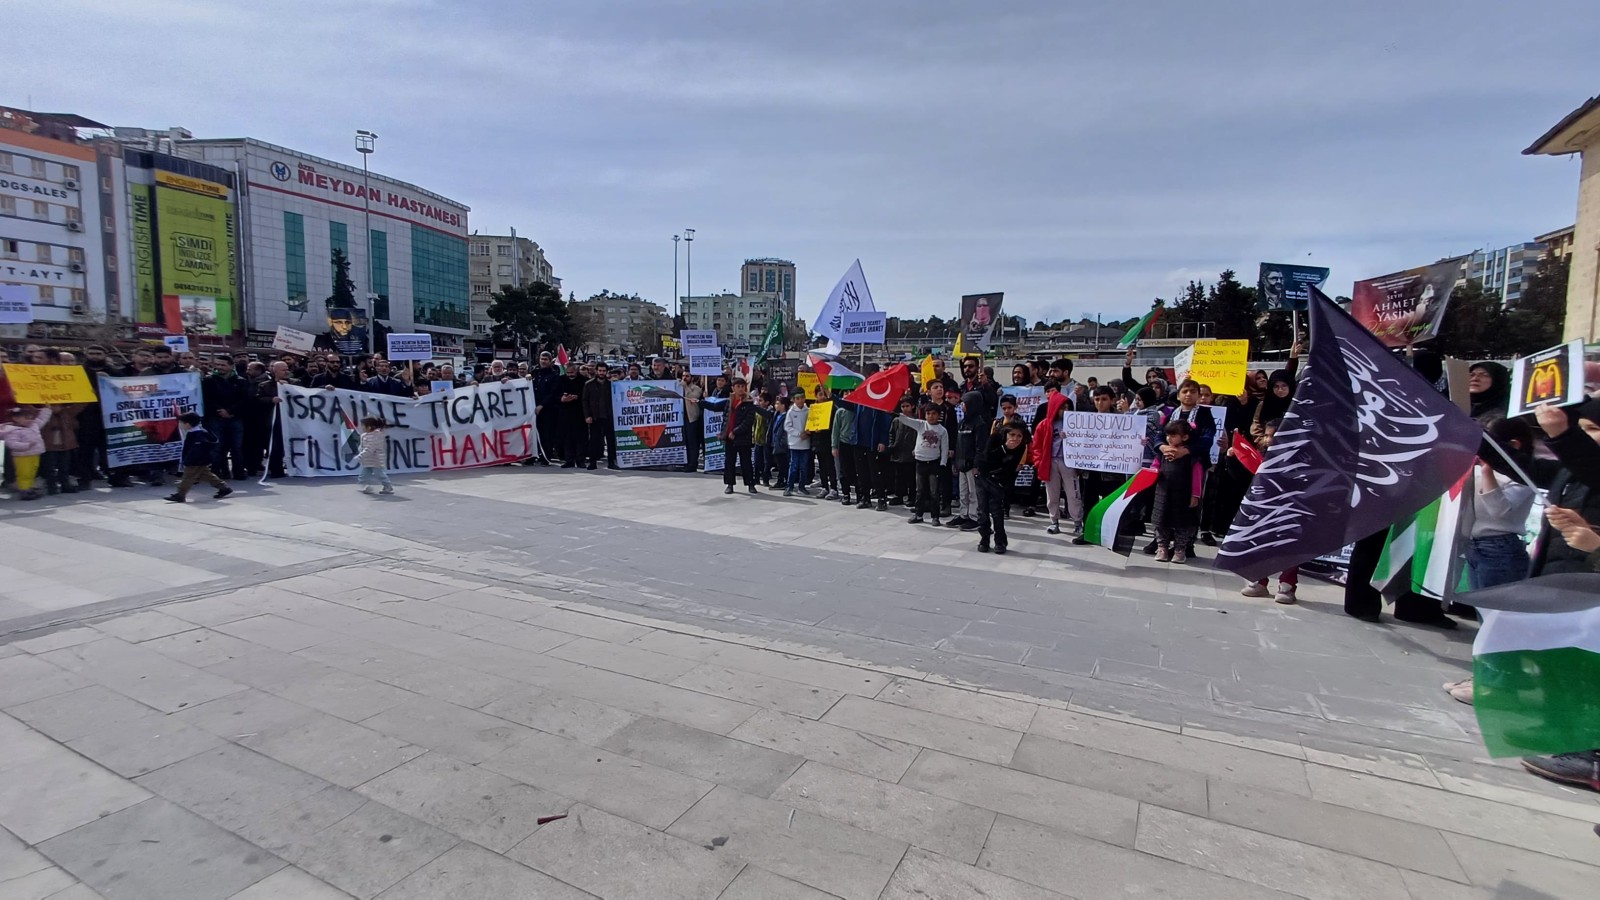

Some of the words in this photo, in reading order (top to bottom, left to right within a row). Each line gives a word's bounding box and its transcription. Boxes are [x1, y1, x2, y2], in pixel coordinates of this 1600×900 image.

[202, 184, 220, 193] TIME
[298, 169, 381, 203] MEYDAN
[387, 192, 461, 228] HASTANESİ
[134, 194, 147, 223] TIME
[136, 226, 151, 276] ENGLISH
[1373, 298, 1417, 312] AHMET
[1377, 309, 1413, 322] YASİN
[420, 386, 530, 428] TİCARET
[1017, 396, 1041, 404] AZZE'DE
[650, 403, 673, 413] TİCARET
[653, 412, 679, 423] İHANET
[430, 424, 532, 467] İHANET
